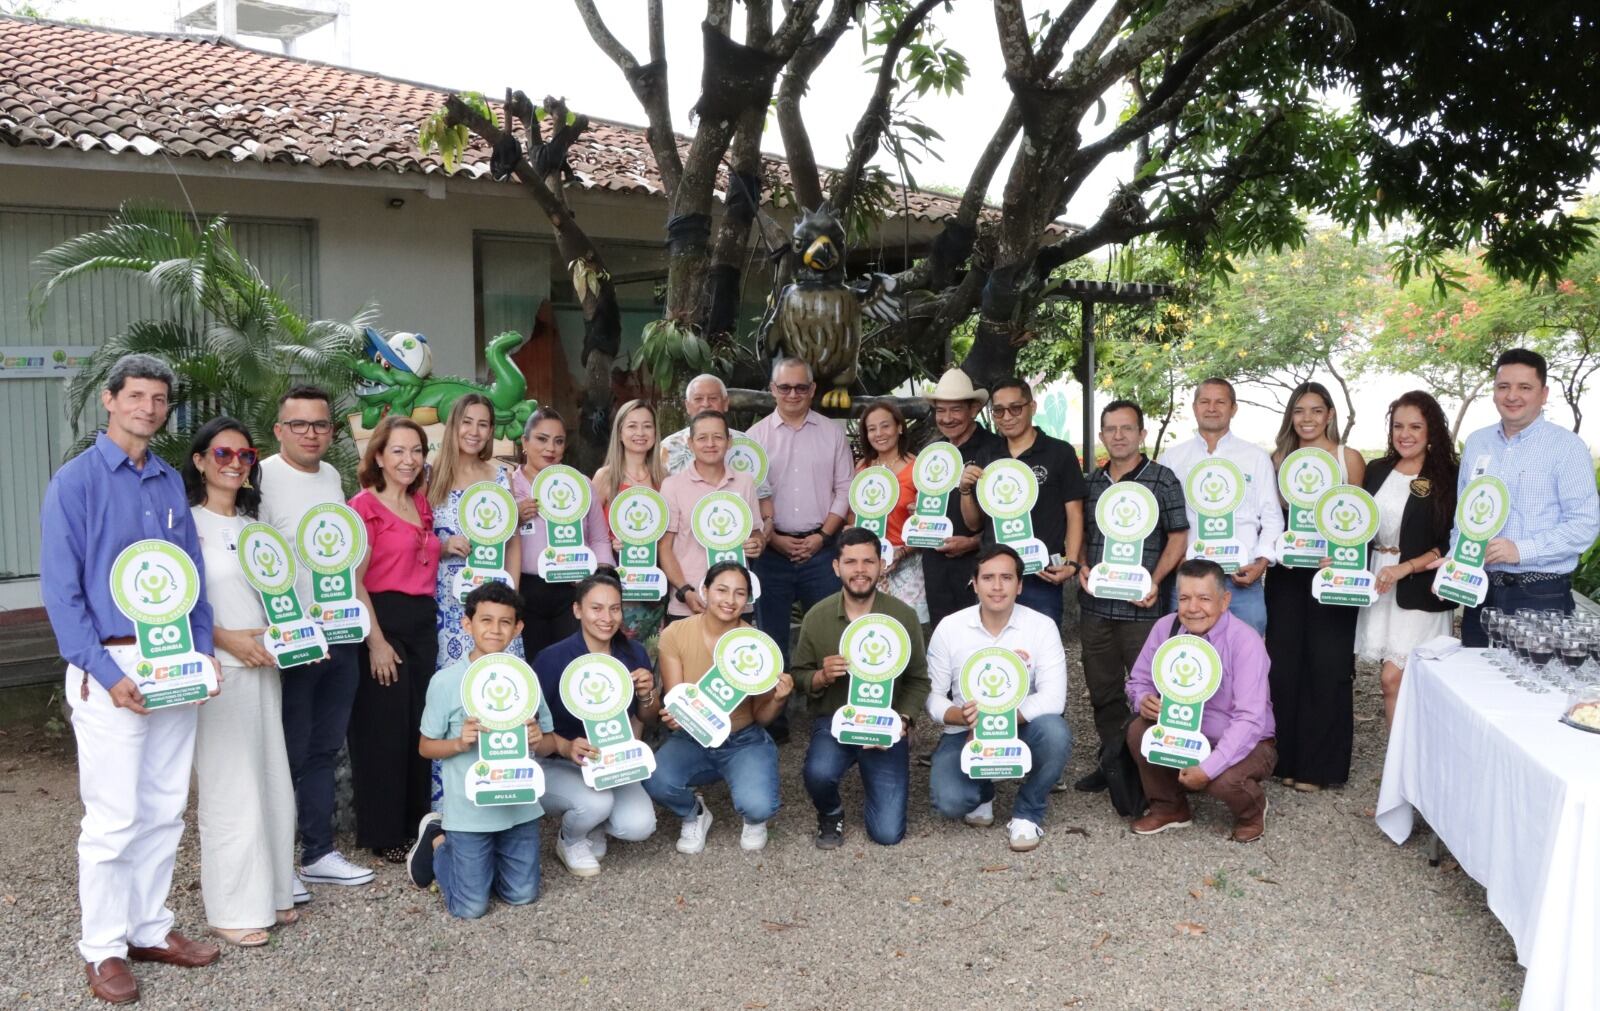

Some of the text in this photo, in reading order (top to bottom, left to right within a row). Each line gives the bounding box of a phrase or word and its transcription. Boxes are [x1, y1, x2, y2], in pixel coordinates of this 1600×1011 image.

[922, 497, 941, 509] CO
[554, 525, 576, 539] CO
[919, 521, 947, 531] cam
[1002, 520, 1024, 534] CO
[1204, 518, 1228, 532] CO
[474, 546, 498, 560] CO
[627, 547, 649, 559] CO
[1111, 543, 1135, 557] CO
[1205, 546, 1239, 555] cam
[1334, 548, 1359, 561] CO
[1461, 540, 1481, 557] CO
[556, 553, 589, 562] cam
[626, 572, 660, 583] cam
[1108, 571, 1144, 582] cam
[1333, 576, 1370, 587] cam
[1453, 570, 1483, 586] cam
[320, 576, 345, 592] CO
[271, 596, 294, 613] CO
[323, 607, 360, 620] cam
[148, 625, 181, 645] CO
[282, 626, 315, 642] cam
[151, 644, 182, 653] COLOMBIA
[155, 661, 203, 680] cam
[710, 678, 735, 701] CO
[858, 683, 884, 698] CO
[691, 700, 726, 730] cam
[1168, 704, 1194, 721] CO
[855, 714, 894, 726] cam
[982, 715, 1008, 731] CO
[595, 720, 622, 737] CO
[488, 732, 518, 749] CO
[1163, 735, 1202, 750] cam
[603, 747, 642, 765] cam
[983, 747, 1022, 757] cam
[490, 767, 534, 780] cam
